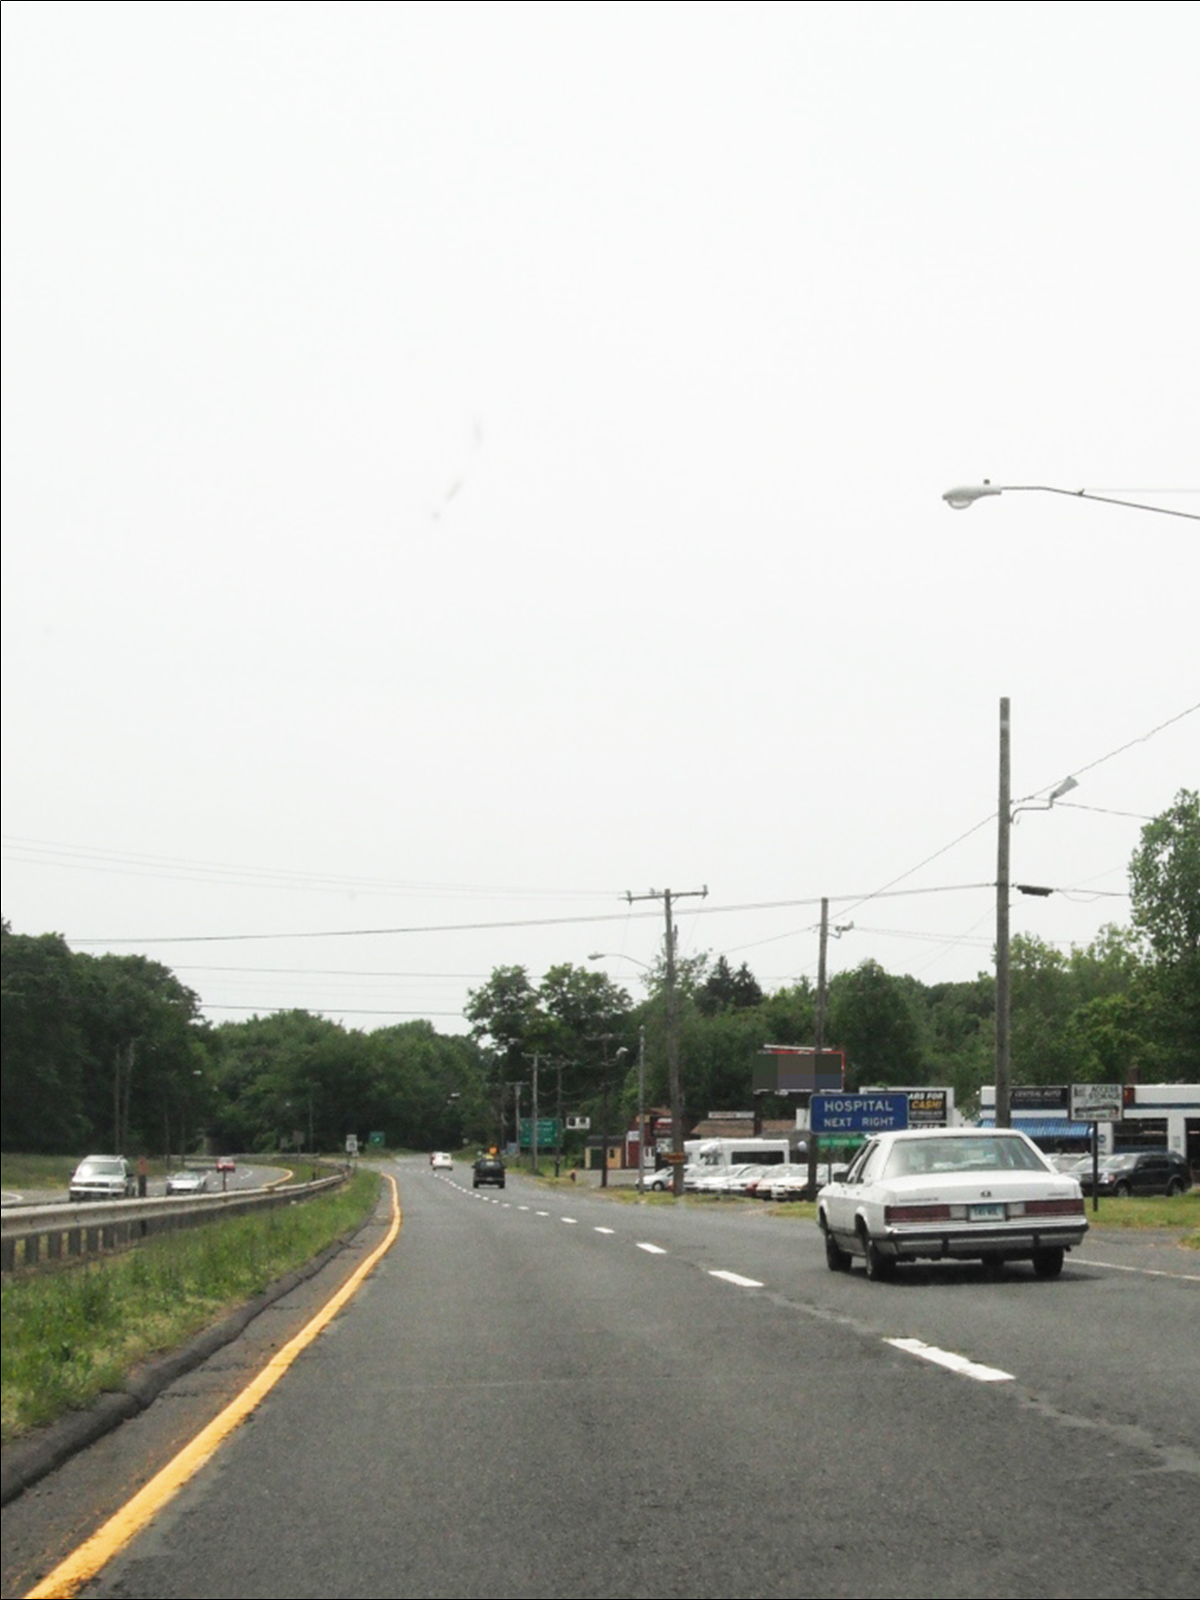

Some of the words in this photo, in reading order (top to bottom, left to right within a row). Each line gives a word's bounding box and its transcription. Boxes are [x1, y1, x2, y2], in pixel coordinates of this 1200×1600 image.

[908, 1092, 926, 1100] ARS
[823, 1100, 895, 1113] HOSPITAL
[823, 1117, 853, 1128] NEXT
[861, 1117, 895, 1128] RIGHT
